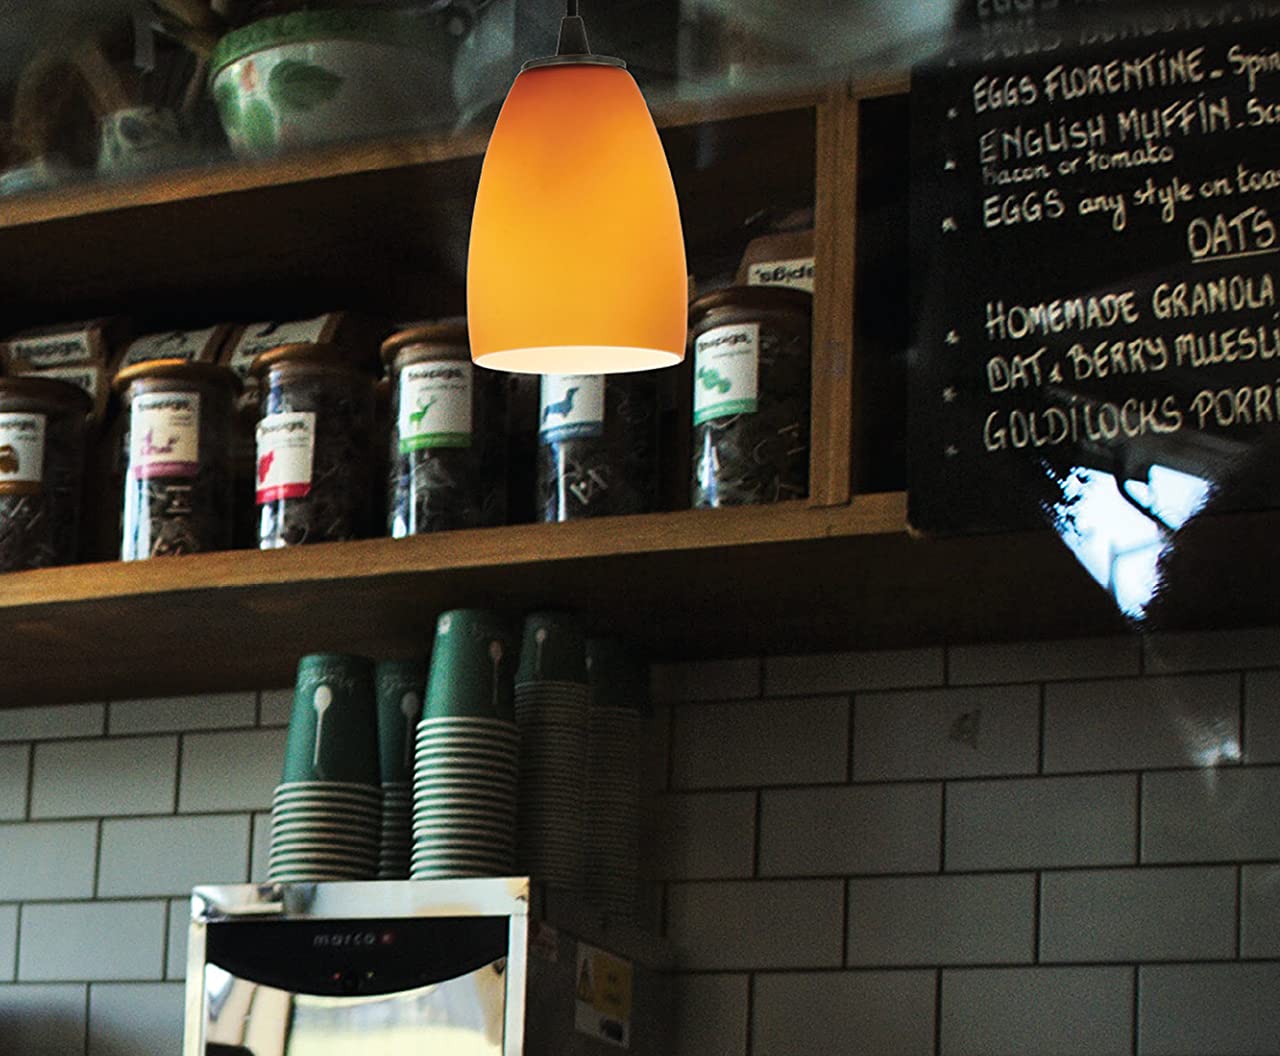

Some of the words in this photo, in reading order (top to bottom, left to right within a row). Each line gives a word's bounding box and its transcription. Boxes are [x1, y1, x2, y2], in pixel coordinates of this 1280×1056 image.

[973, 75, 1038, 113] EGGS
[1042, 47, 1206, 101] FLORENTINE
[979, 117, 1108, 164] ENGLISH
[1057, 157, 1080, 176] or
[1086, 141, 1175, 171] tomato
[982, 188, 1066, 229] EGGS
[1078, 193, 1127, 231] any
[1133, 176, 1194, 223] style
[1199, 175, 1233, 198] on
[1187, 206, 1277, 258] OATS
[985, 289, 1140, 340] HOMEMADE
[1152, 273, 1276, 320] GRANOLA
[1066, 337, 1168, 380] BERRY
[982, 396, 1183, 452] GOLDILOCKS
